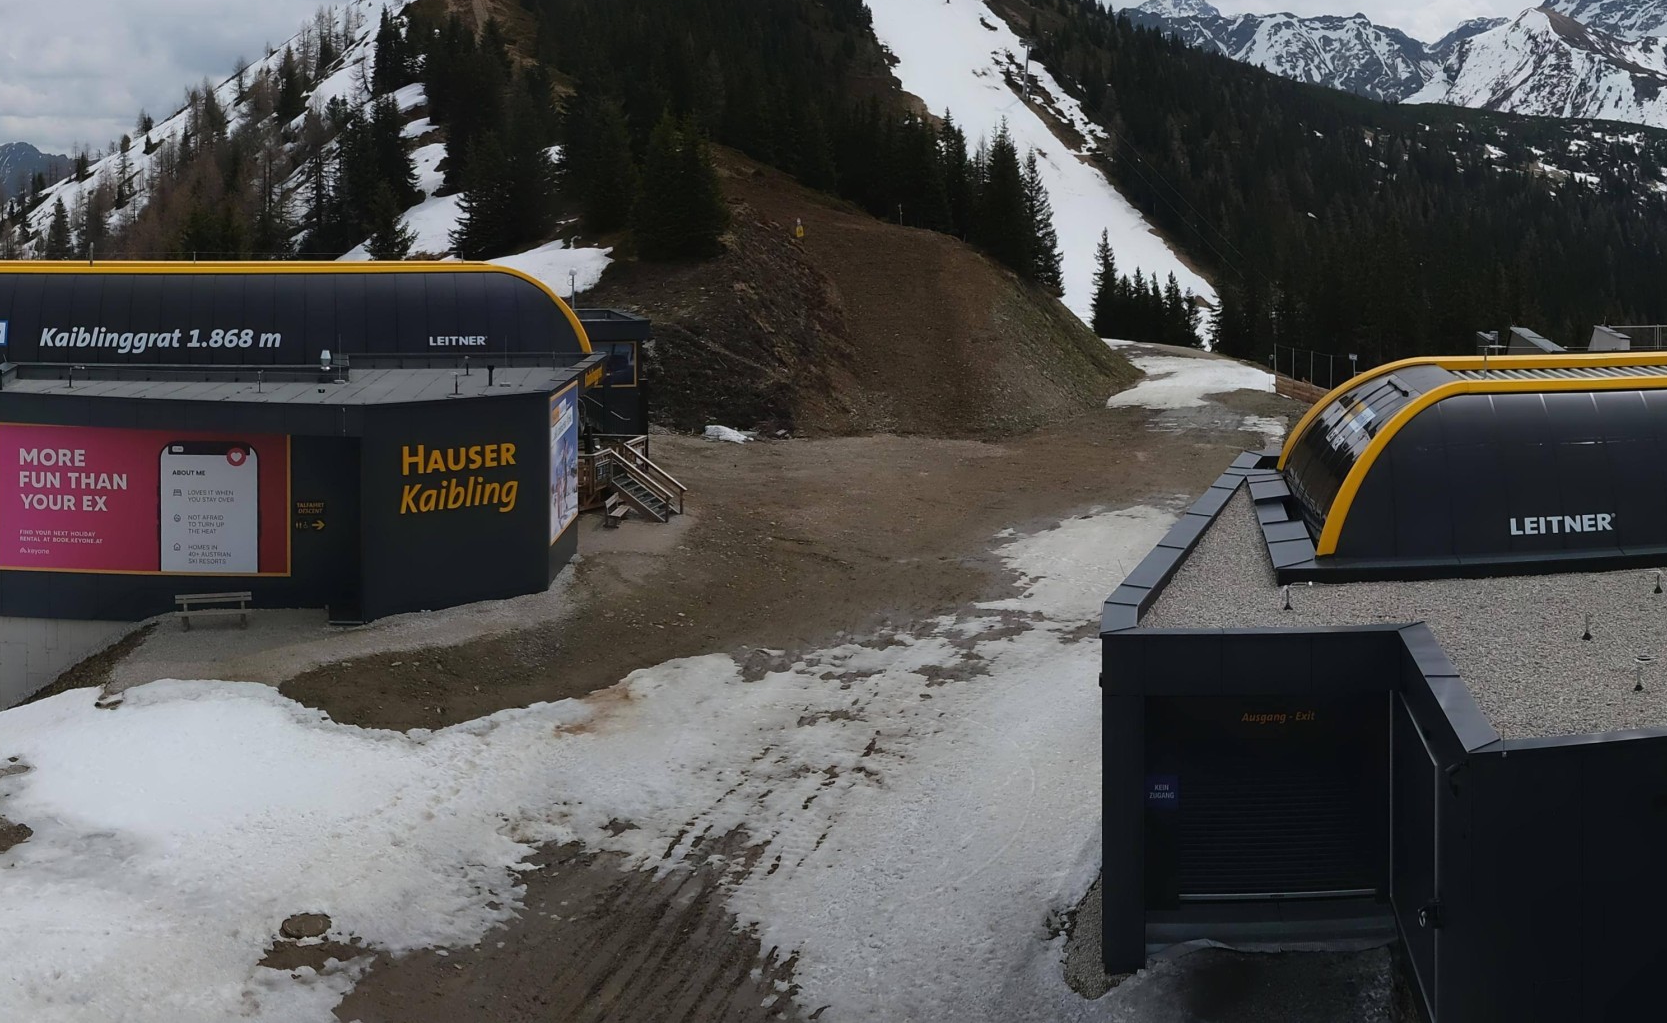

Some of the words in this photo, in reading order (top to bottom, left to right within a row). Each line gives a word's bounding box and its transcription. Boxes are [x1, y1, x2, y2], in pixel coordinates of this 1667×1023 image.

[39, 326, 182, 354] Kaiblinggrat
[186, 329, 254, 348] 1.868
[258, 332, 282, 348] m
[429, 336, 487, 346] LEITNER
[20, 448, 86, 466] MORE
[402, 443, 517, 476] HAUSER
[20, 471, 60, 488] FUN
[67, 472, 127, 490] THAN
[20, 494, 76, 511] YOUR
[82, 496, 108, 512] EX
[400, 476, 519, 514] Kaibling
[1510, 513, 1613, 535] LEITNER
[1241, 712, 1287, 725] Ausgang
[1295, 710, 1315, 721] Exit
